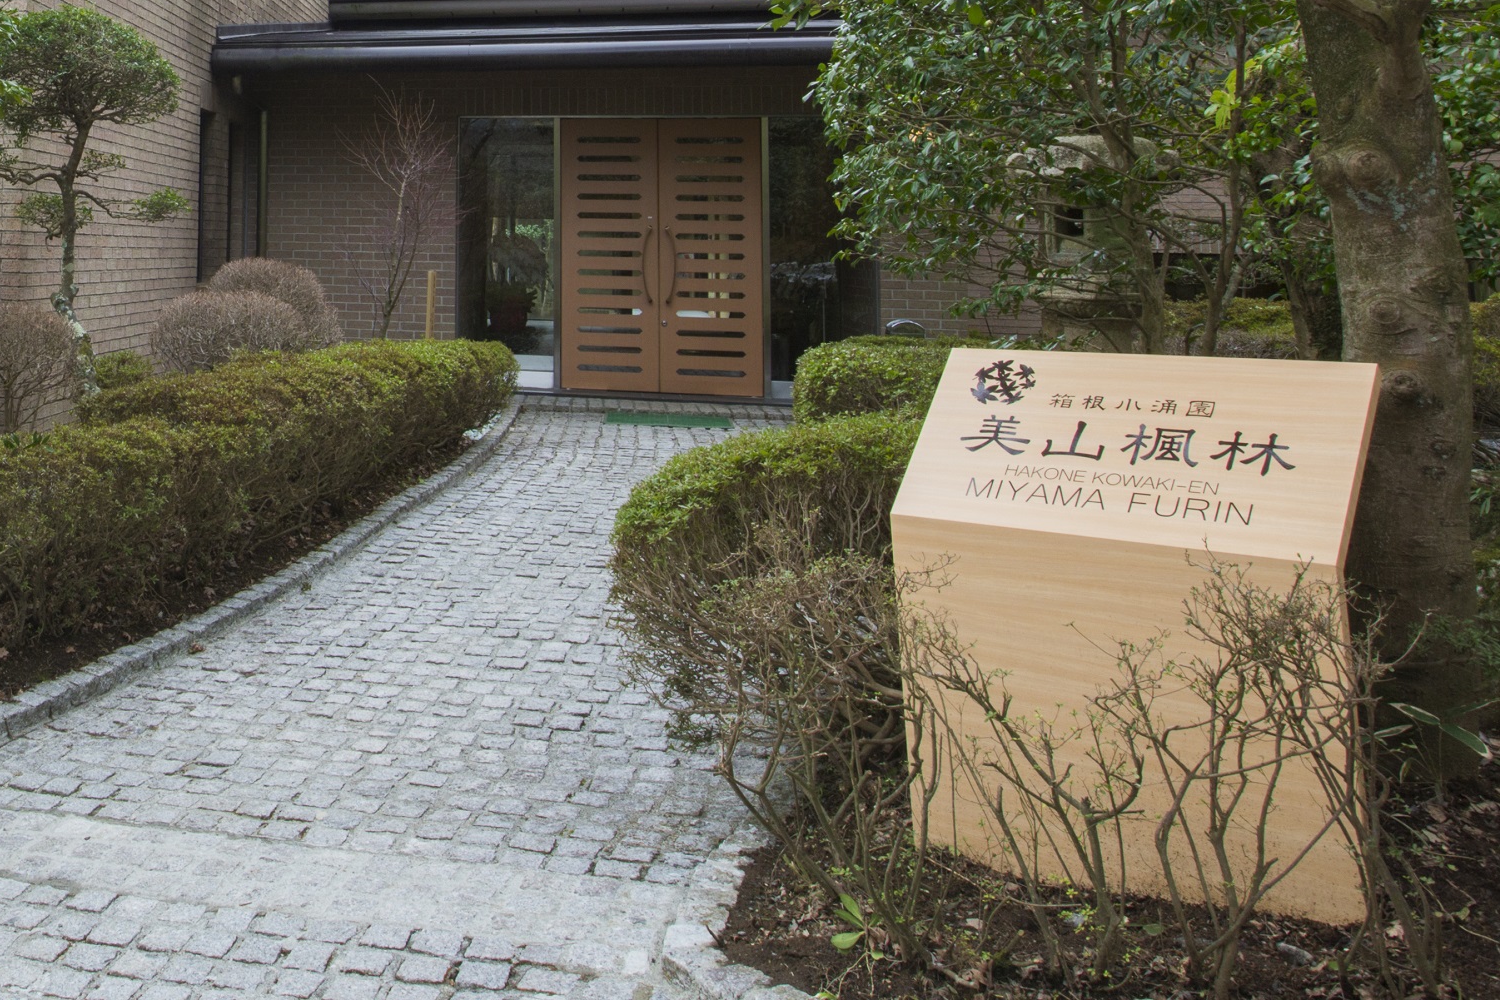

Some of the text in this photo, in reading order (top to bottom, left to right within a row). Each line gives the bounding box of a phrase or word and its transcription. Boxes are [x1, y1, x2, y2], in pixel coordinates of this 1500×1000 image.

[1049, 393, 1215, 418] 箱根小涌園
[960, 414, 1296, 476] 美山楓林
[1004, 464, 1220, 496] HAKONE KOWAKI-EN
[965, 477, 1255, 526] MIYAMA FURIN
